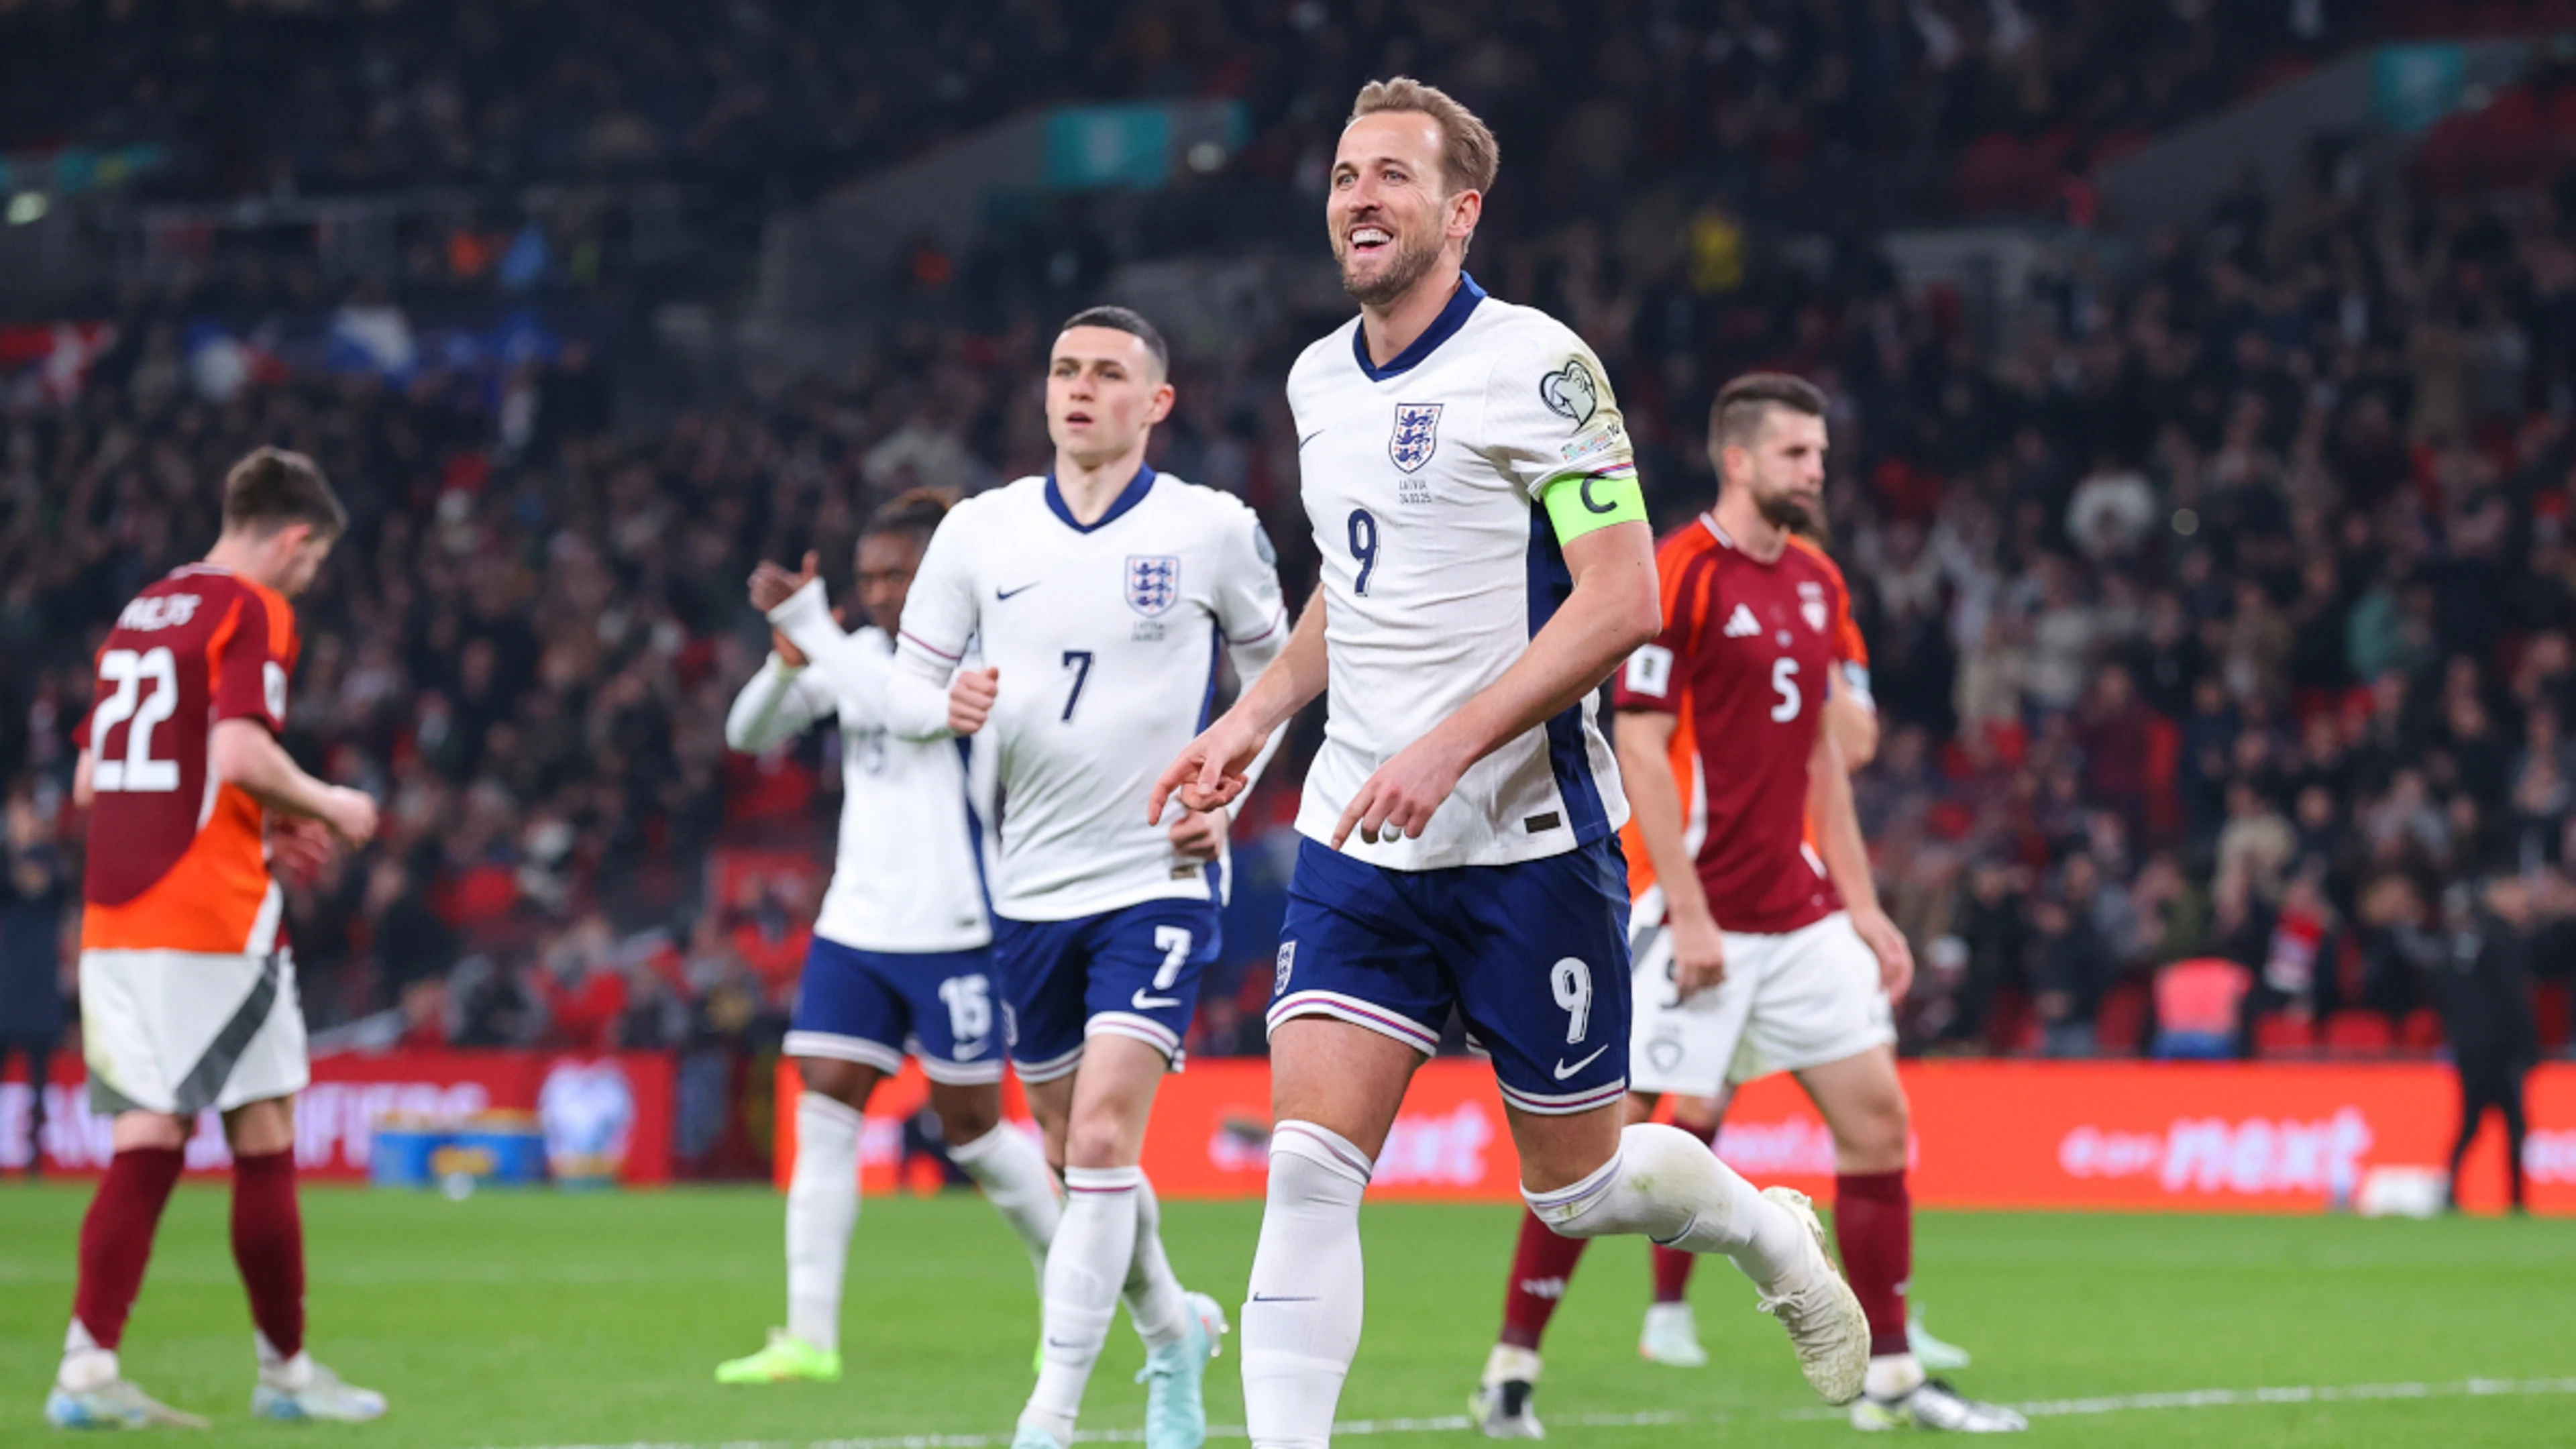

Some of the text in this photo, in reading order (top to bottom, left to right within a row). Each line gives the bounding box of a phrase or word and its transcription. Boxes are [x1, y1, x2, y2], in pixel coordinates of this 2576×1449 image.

[1580, 472, 1618, 514] C
[1348, 508, 1381, 597] 9
[90, 647, 179, 792] 22
[1061, 650, 1094, 722] 7
[1770, 657, 1801, 722] 5
[1155, 925, 1192, 989] 7
[938, 973, 991, 1042] 15
[1550, 957, 1591, 1044] 9
[2159, 1104, 2373, 1193] next
